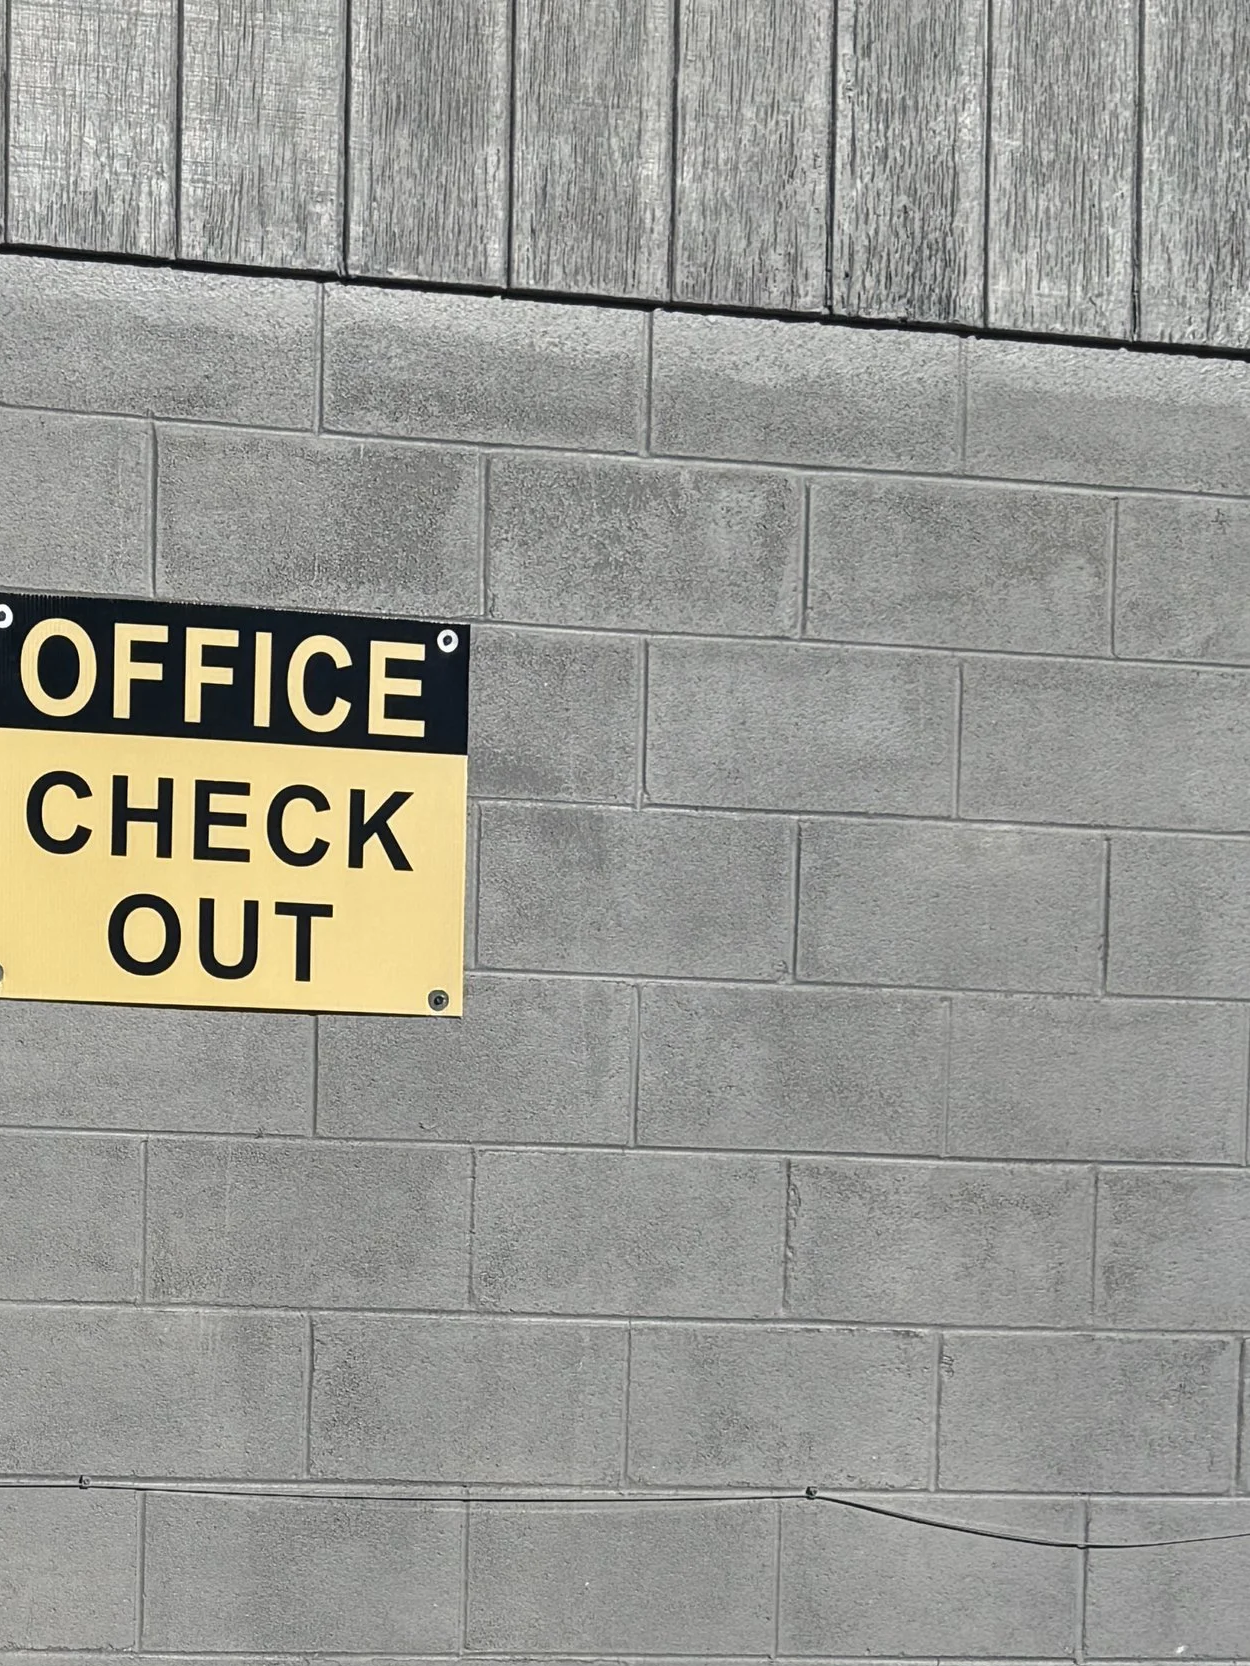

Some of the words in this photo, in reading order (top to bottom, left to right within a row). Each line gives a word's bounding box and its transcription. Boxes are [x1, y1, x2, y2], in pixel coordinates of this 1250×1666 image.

[20, 617, 426, 738] OFFICE
[26, 770, 415, 872] CHECK
[107, 893, 334, 983] OUT
